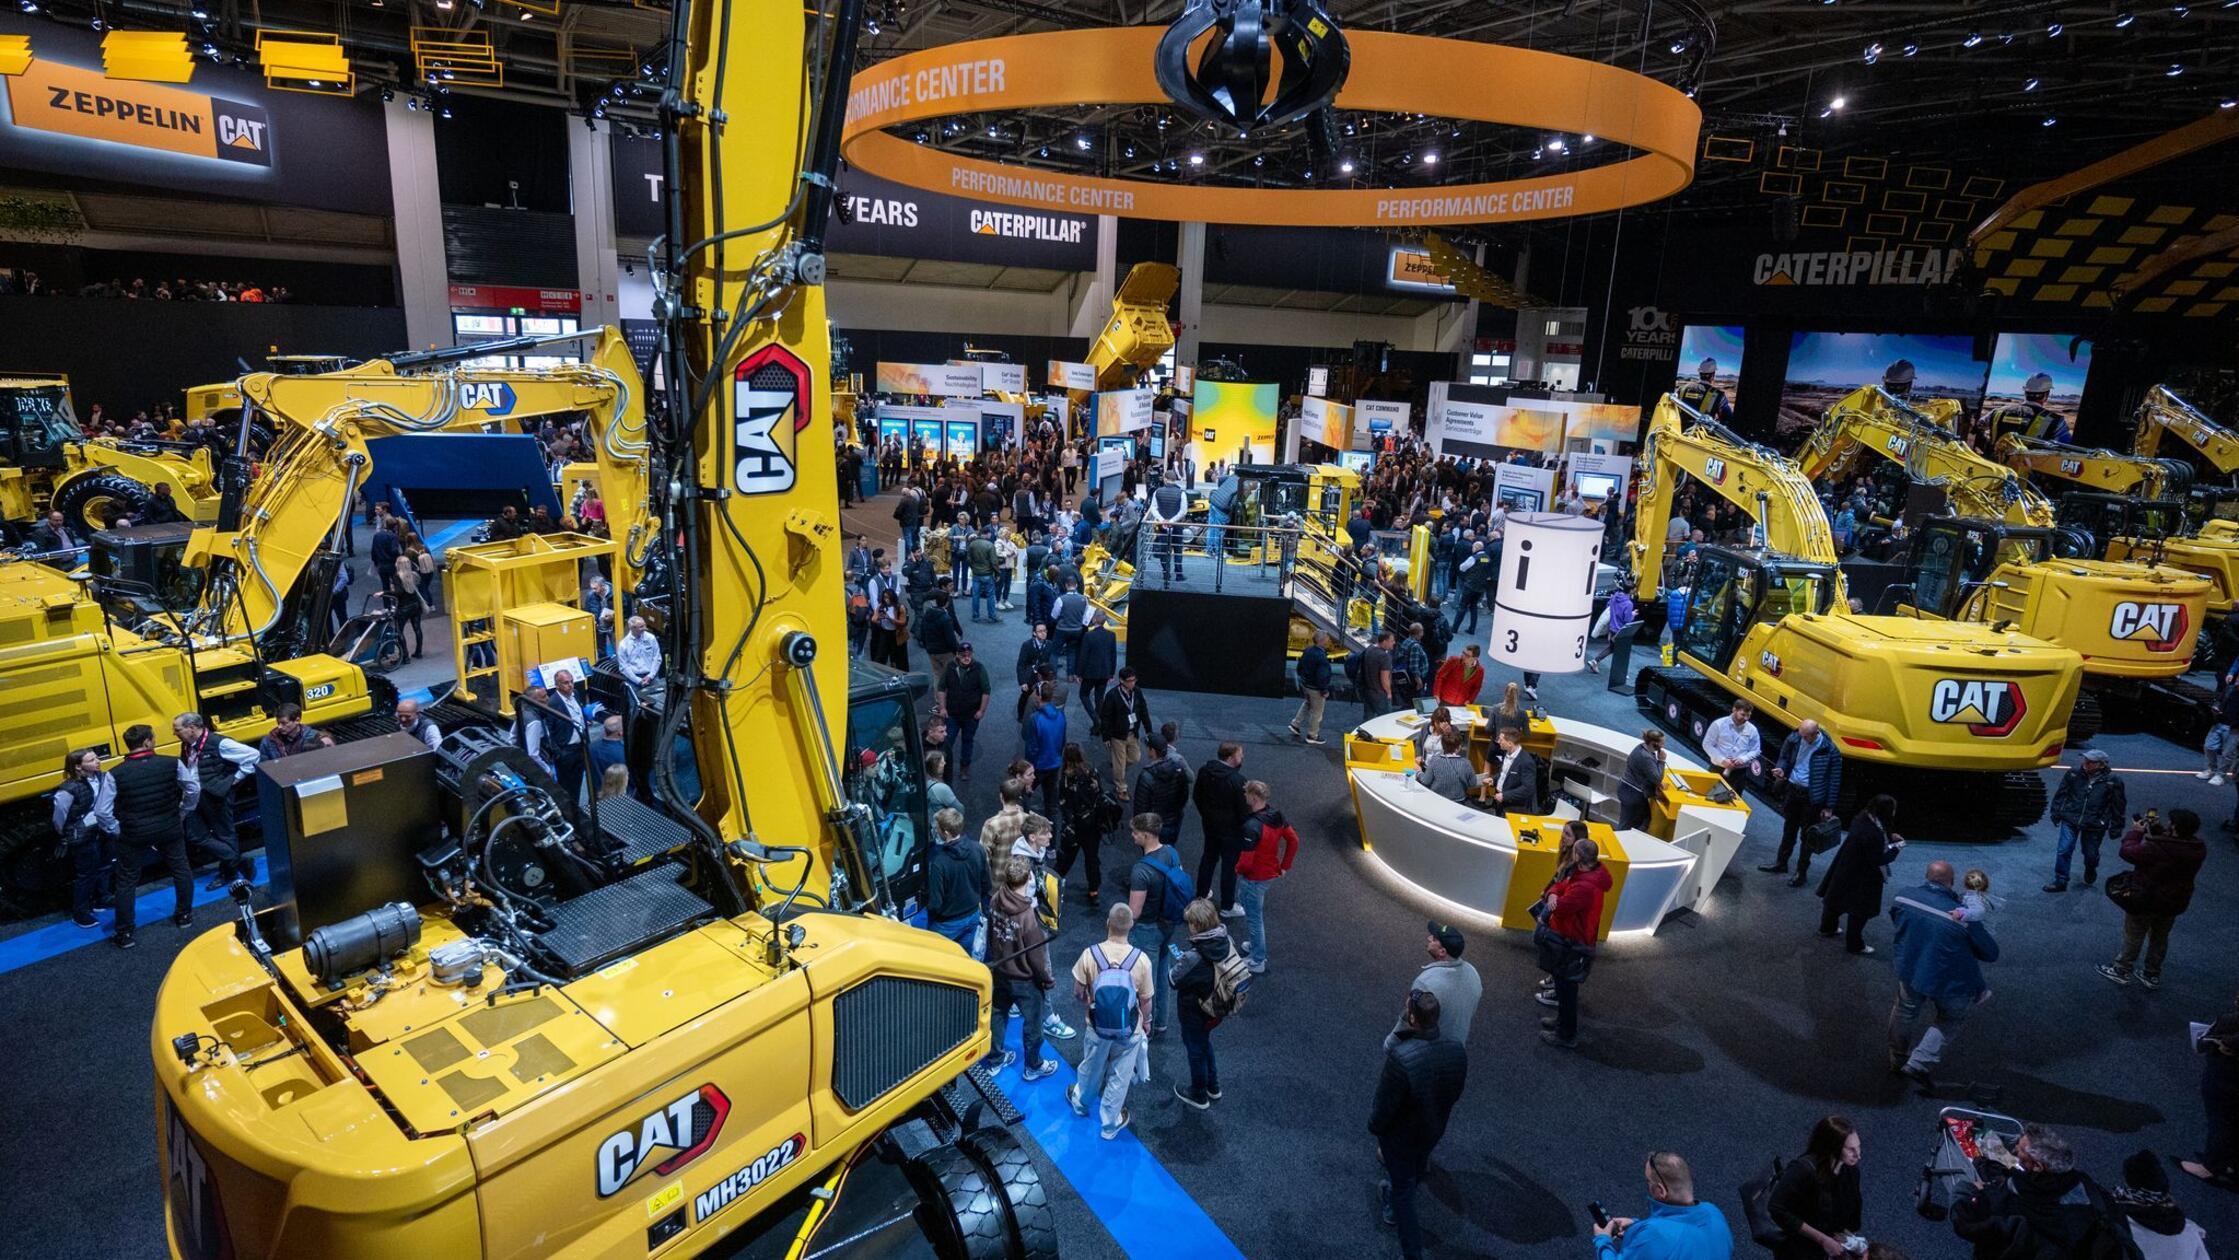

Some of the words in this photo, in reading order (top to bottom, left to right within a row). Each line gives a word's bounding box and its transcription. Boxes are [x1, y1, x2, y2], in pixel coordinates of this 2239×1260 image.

[843, 73, 910, 126] ORMANCE
[915, 59, 1006, 103] CENTER
[47, 86, 201, 134] ZEPPELIN
[952, 167, 1065, 204] PERFORMANCE
[1069, 186, 1135, 210] CENTER
[1377, 193, 1508, 219] PERFORMANCE
[1511, 186, 1574, 213] CENTER
[461, 383, 502, 409] CAT
[1446, 409, 1469, 417] Customer
[1470, 411, 1484, 419] Value
[1446, 417, 1474, 426] Agreements
[736, 381, 794, 495] CAT
[1887, 435, 1907, 456] CAT
[1705, 457, 1725, 479] CAT
[2061, 460, 2082, 475] CAT
[2111, 602, 2180, 643] CAT
[1505, 629, 1519, 653] 3
[1575, 635, 1585, 659] 3
[1762, 651, 1779, 672] CAT
[306, 685, 329, 699] 320
[1932, 680, 2008, 724] CAT
[598, 1089, 701, 1197] CAT
[697, 1138, 794, 1224] MH3022
